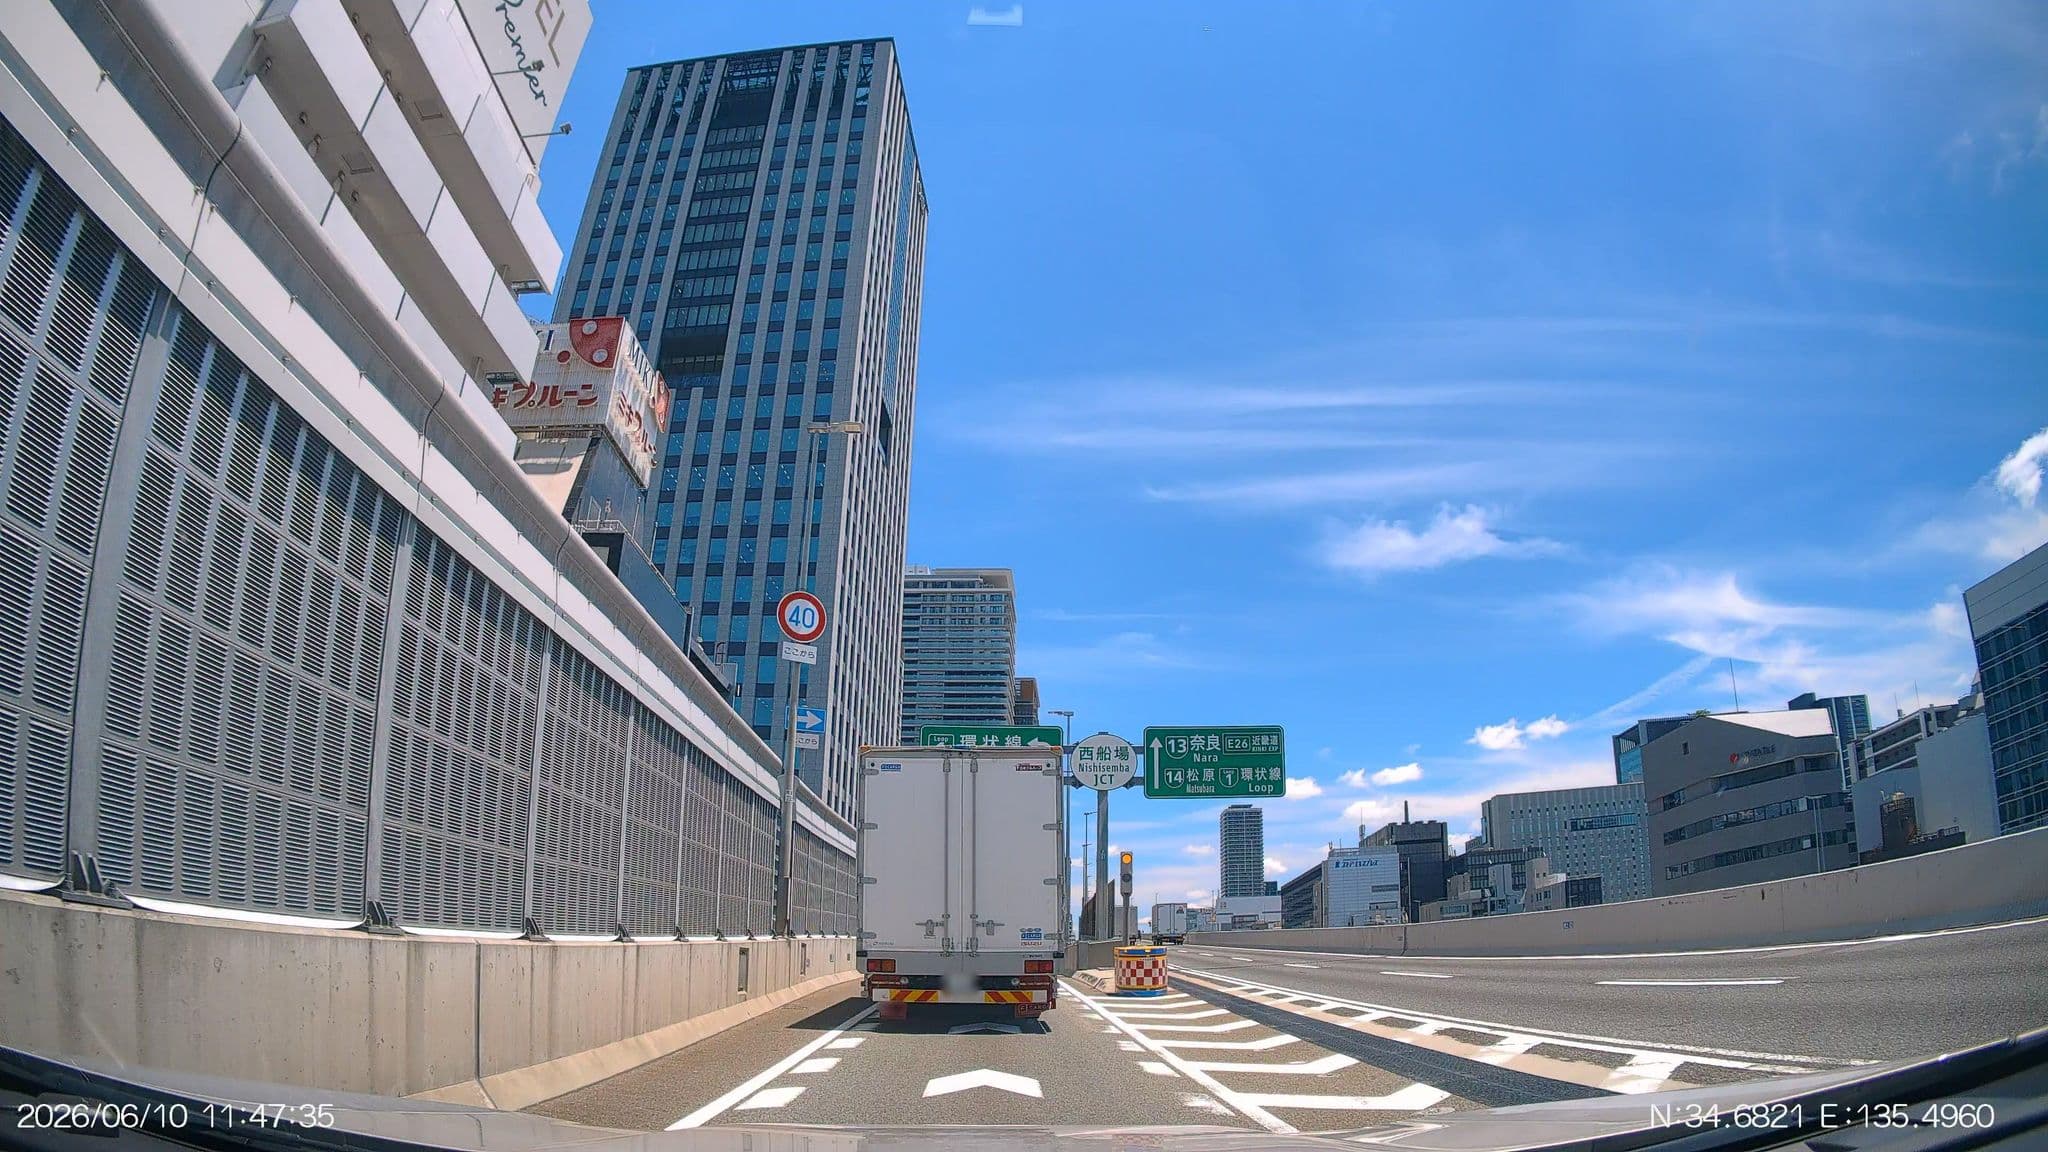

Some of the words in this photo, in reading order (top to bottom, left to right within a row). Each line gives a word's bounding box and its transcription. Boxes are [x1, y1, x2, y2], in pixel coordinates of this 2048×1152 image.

[788, 605, 815, 628] 40
[784, 645, 815, 660] ここから
[795, 736, 818, 746] こから
[934, 735, 949, 743] Loop
[1190, 734, 1221, 751] 奈良
[1228, 739, 1248, 749] E26
[1168, 739, 1187, 753] 13
[1078, 746, 1130, 761] 西船場
[1193, 753, 1219, 763] Nara
[1078, 762, 1130, 773] Nishisemba
[1240, 767, 1281, 781] 環状線
[1093, 774, 1115, 787] JCT
[1166, 770, 1184, 784] 14
[1186, 767, 1216, 782] 松原
[1225, 774, 1232, 786] 1
[1248, 782, 1274, 794] Loop
